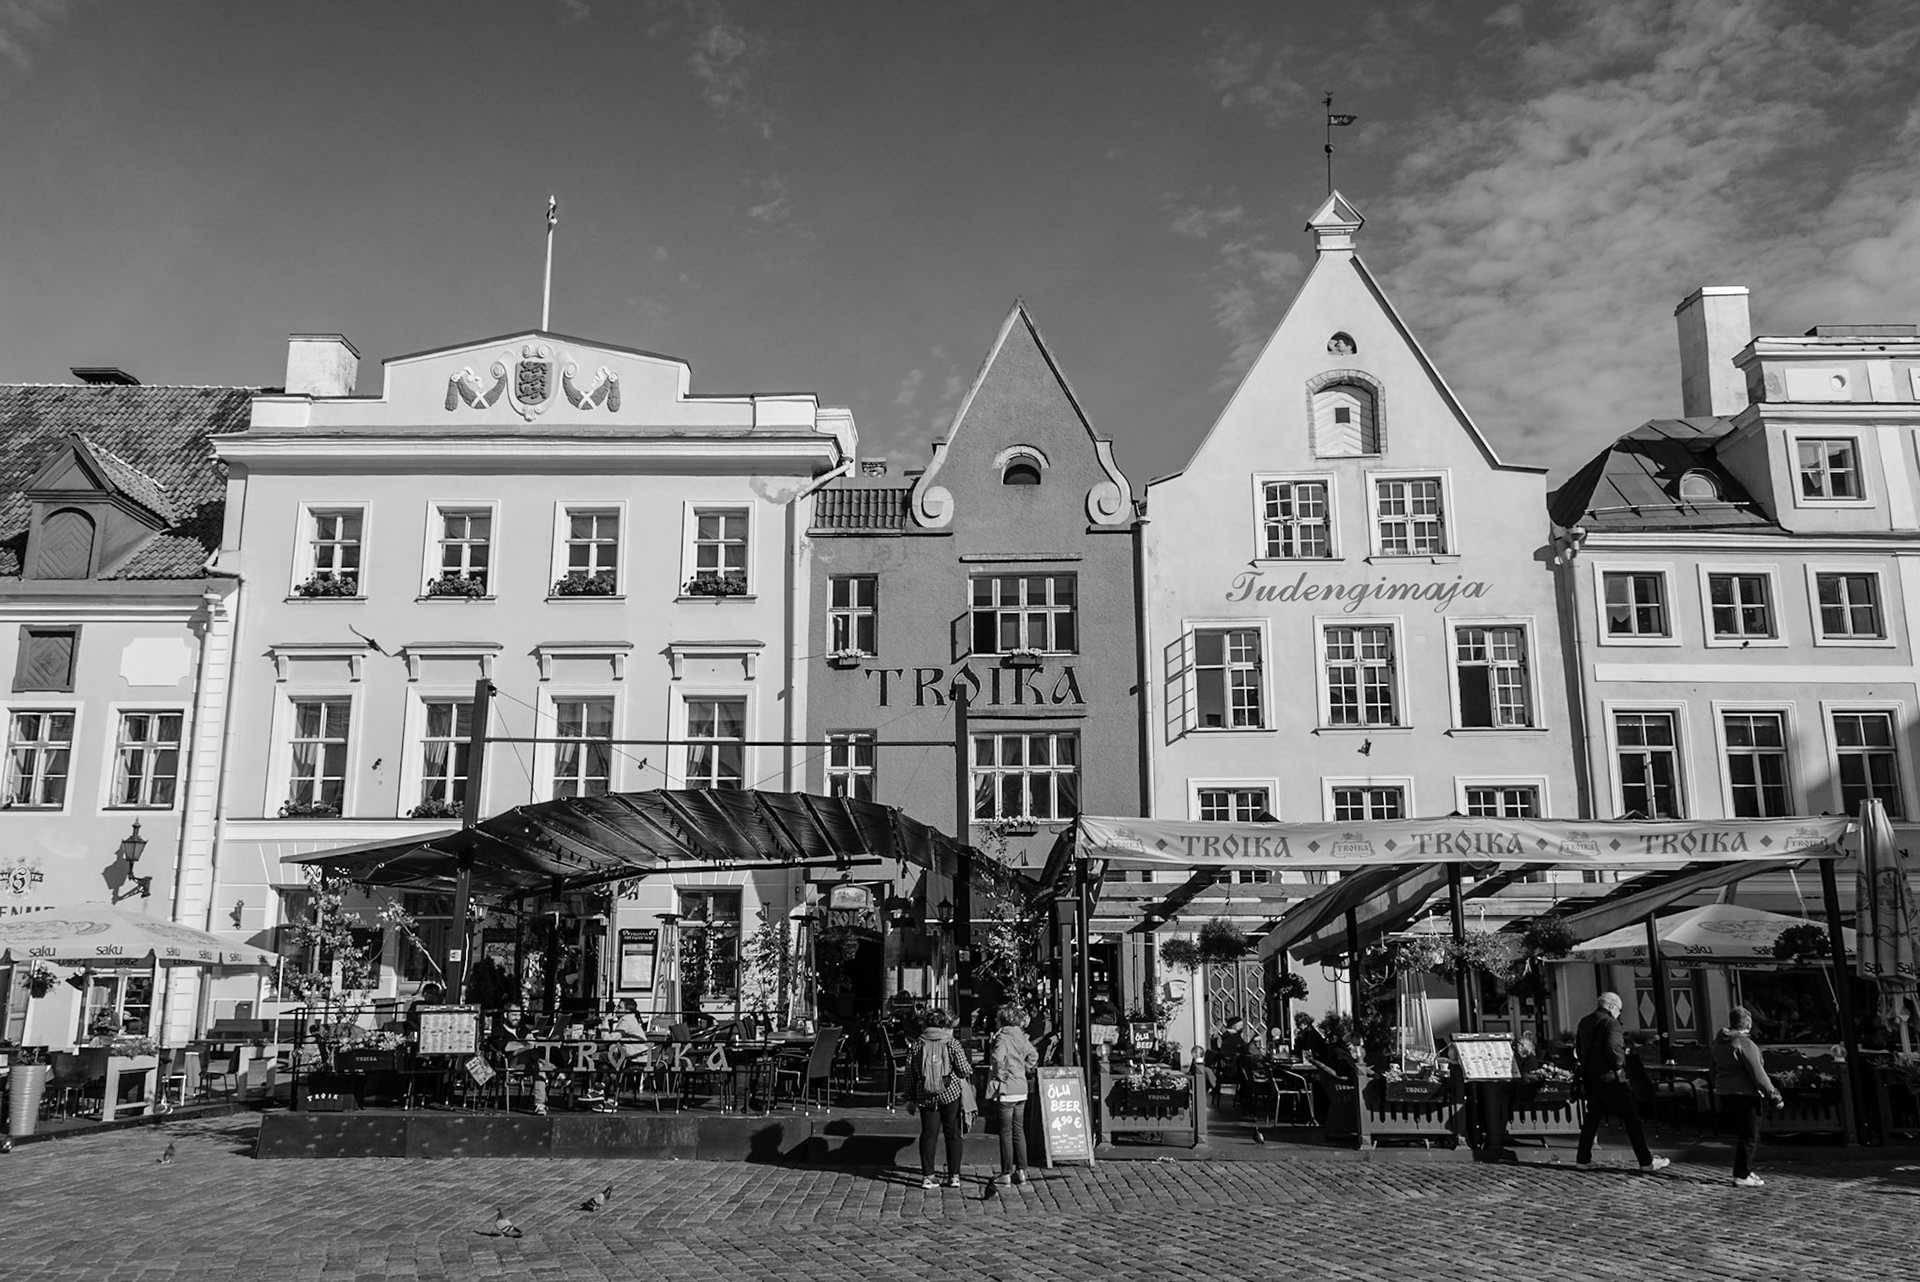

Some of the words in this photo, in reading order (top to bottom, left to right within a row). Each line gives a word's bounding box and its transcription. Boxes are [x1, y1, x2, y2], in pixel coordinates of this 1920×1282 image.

[1225, 571, 1495, 613] Tudengimaja
[864, 662, 1087, 708] TROIKA
[1180, 833, 1293, 859] TROIKA
[1337, 844, 1369, 853] TROIKA
[1411, 829, 1526, 856] TROIKA
[1563, 843, 1596, 852] TROIKA
[1639, 830, 1750, 856] TROIKA
[28, 945, 56, 957] saku
[95, 944, 124, 956] saku
[1683, 944, 1713, 955] saku
[536, 1042, 732, 1072] TROIKA
[1050, 1099, 1082, 1114] BEER
